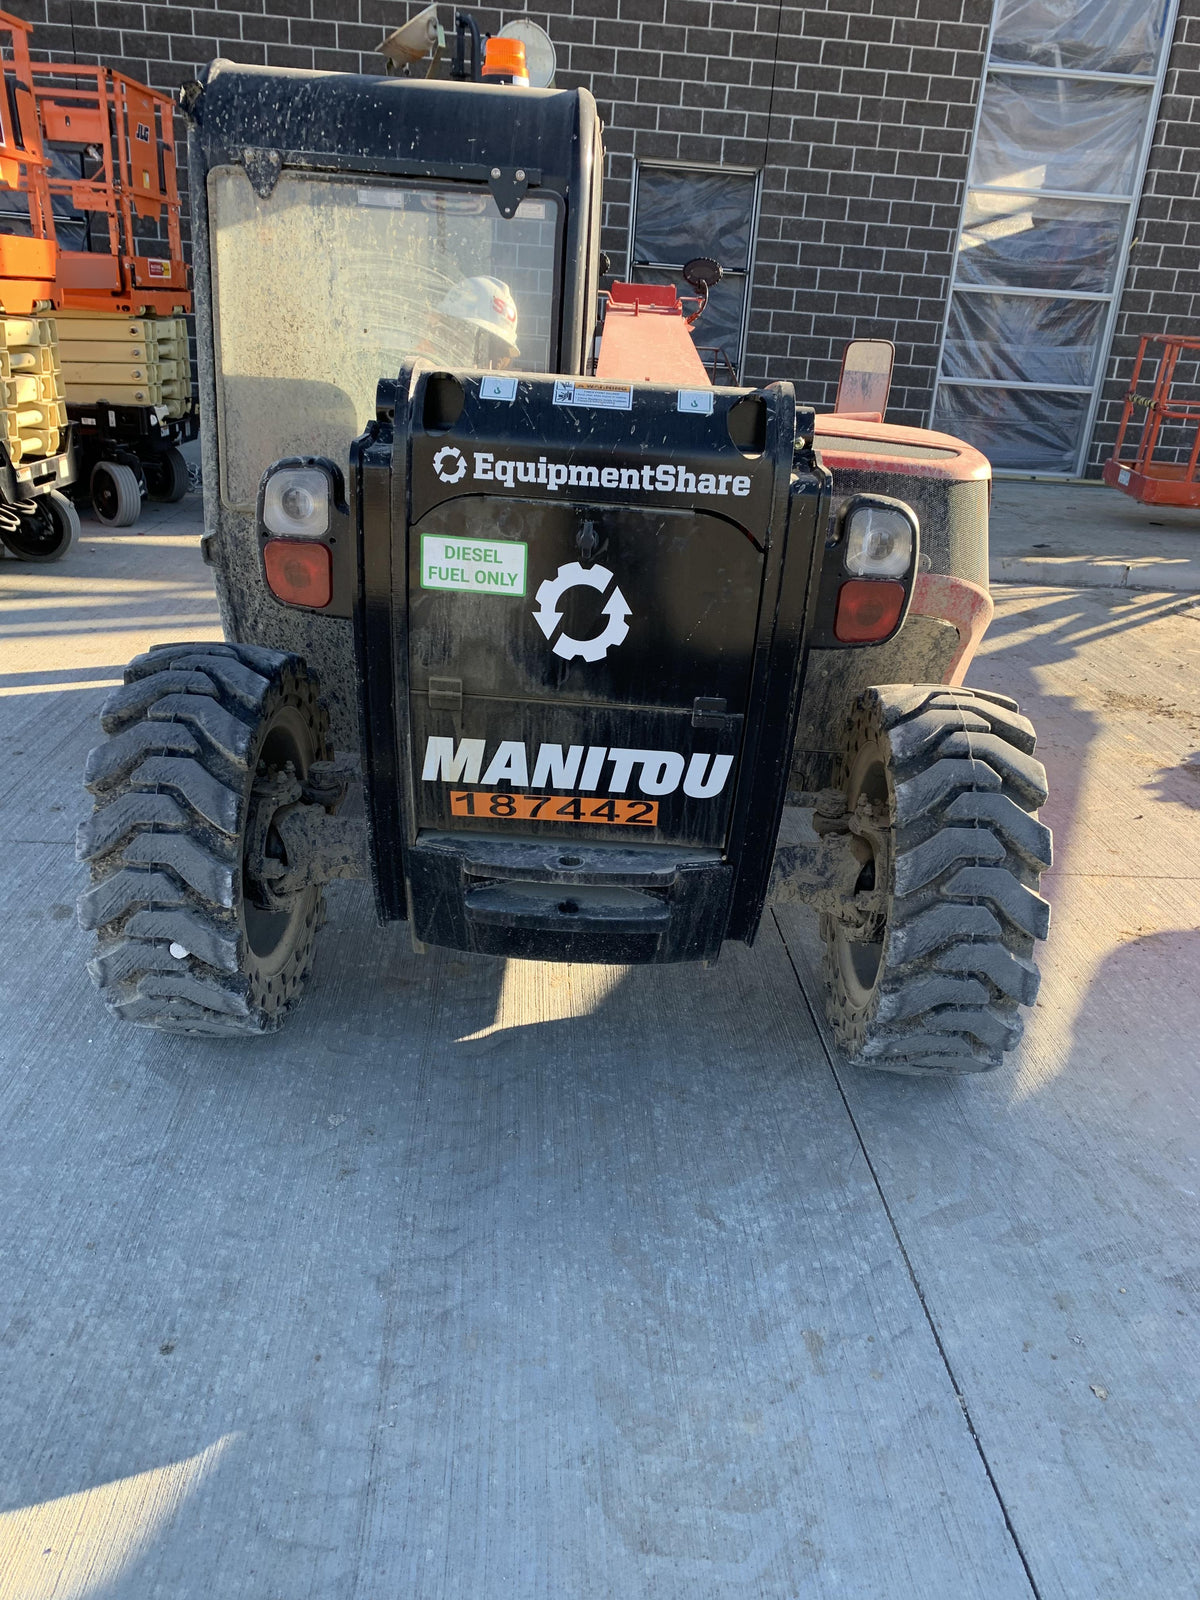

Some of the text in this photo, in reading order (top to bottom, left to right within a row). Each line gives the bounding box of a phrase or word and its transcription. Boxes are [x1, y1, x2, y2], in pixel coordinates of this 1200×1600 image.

[136, 122, 149, 142] JLG
[473, 452, 750, 496] EquipmentShare
[444, 545, 503, 564] DIESEL
[428, 566, 518, 587] FUEL ONLY
[421, 736, 734, 799] MANITOU
[455, 792, 654, 824] 187442
